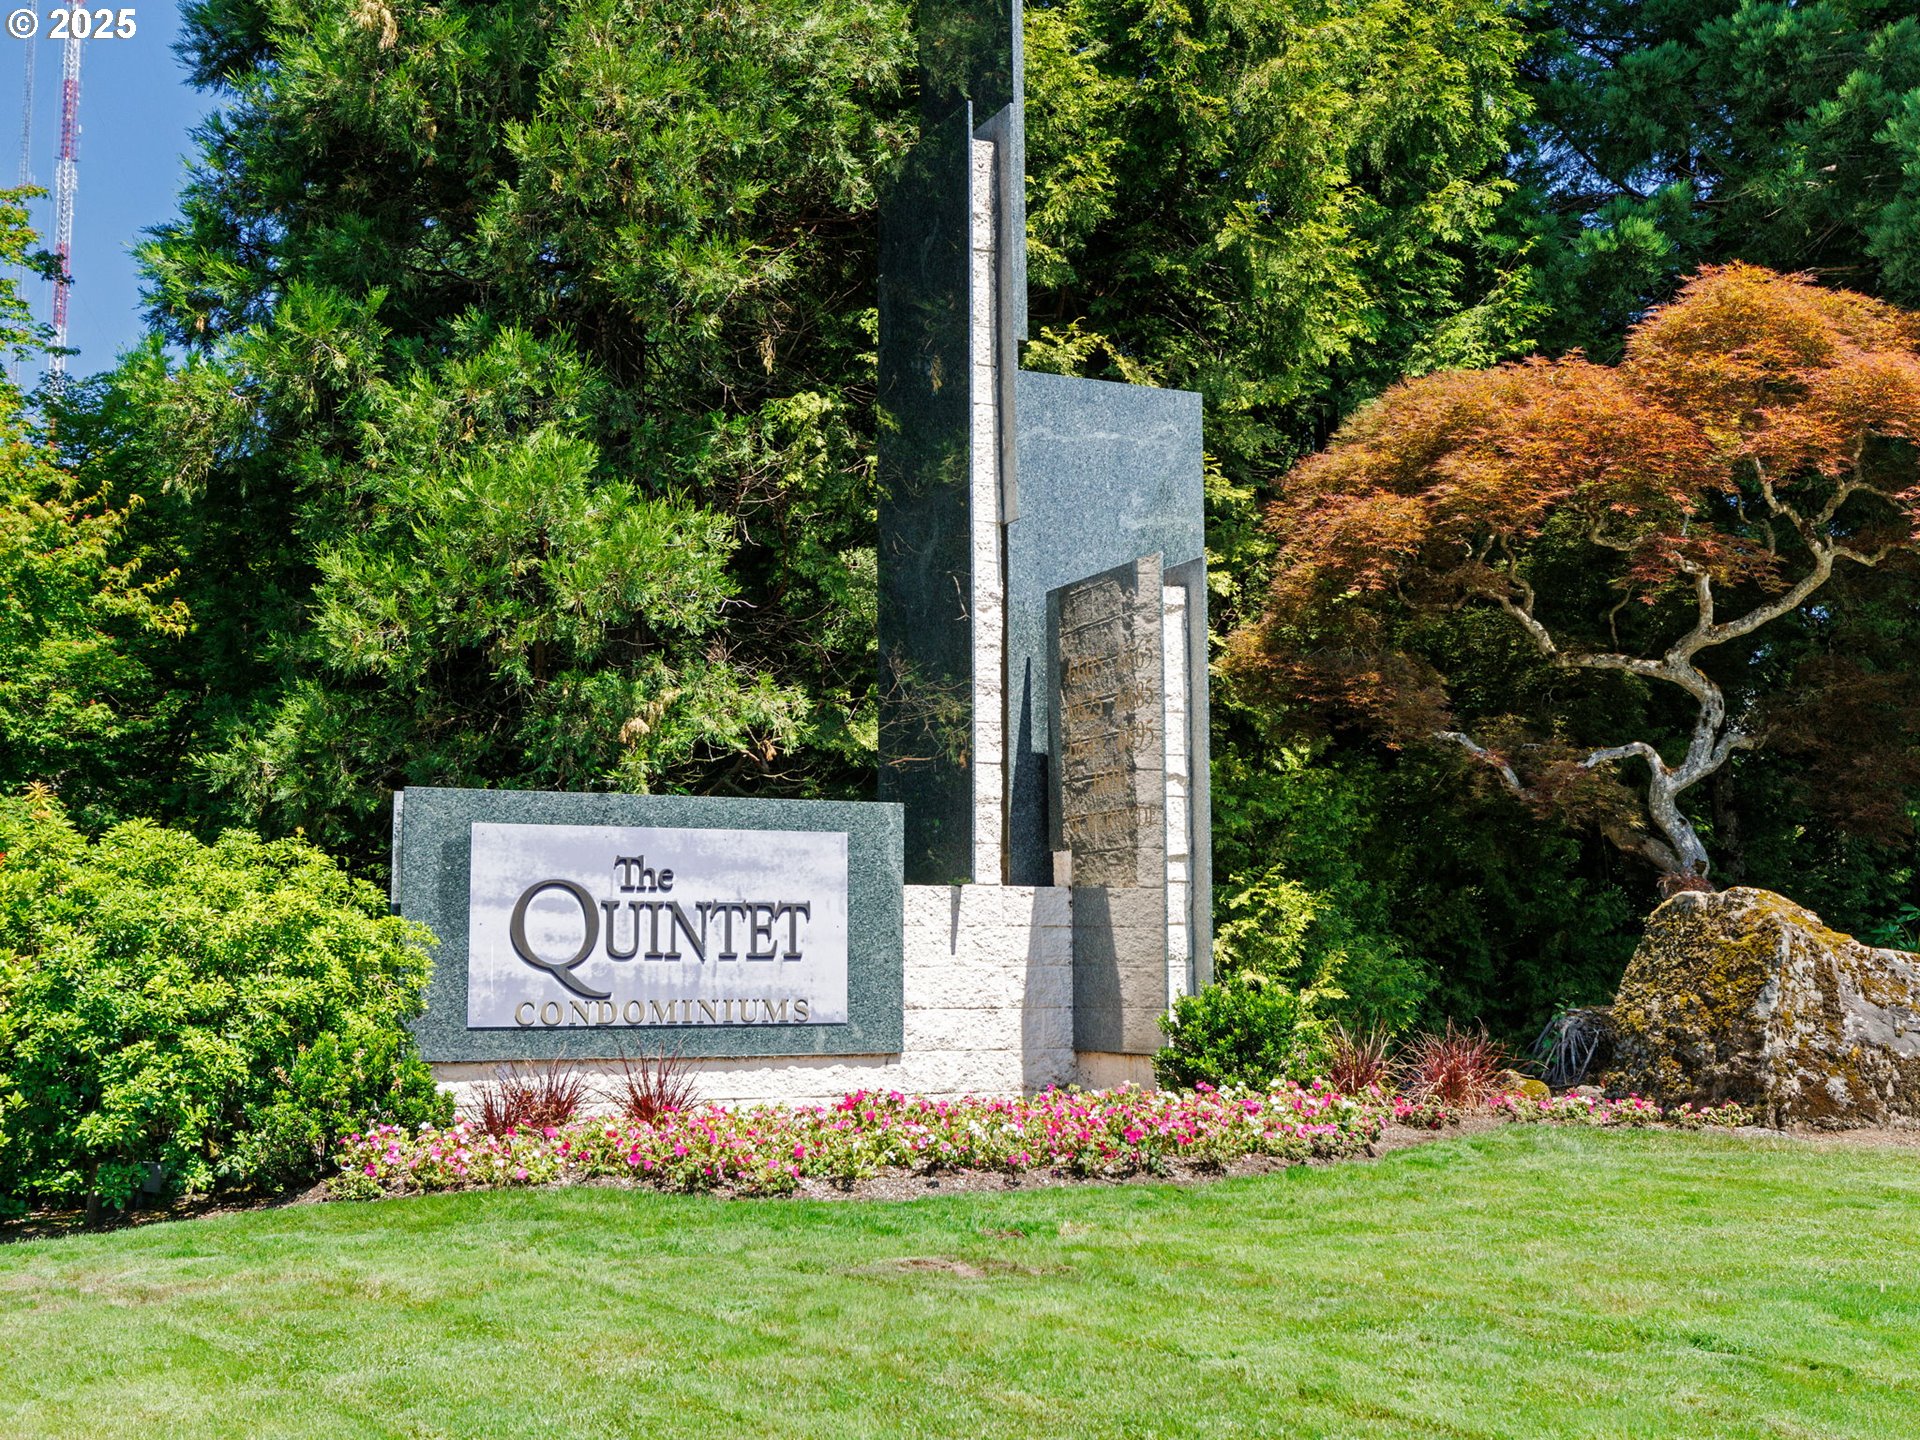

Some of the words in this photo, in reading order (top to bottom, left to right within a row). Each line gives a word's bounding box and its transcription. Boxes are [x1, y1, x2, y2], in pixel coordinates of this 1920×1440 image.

[614, 854, 674, 893] The
[509, 878, 811, 1000] QUINTET
[514, 999, 811, 1026] CONDOMINIUMS
